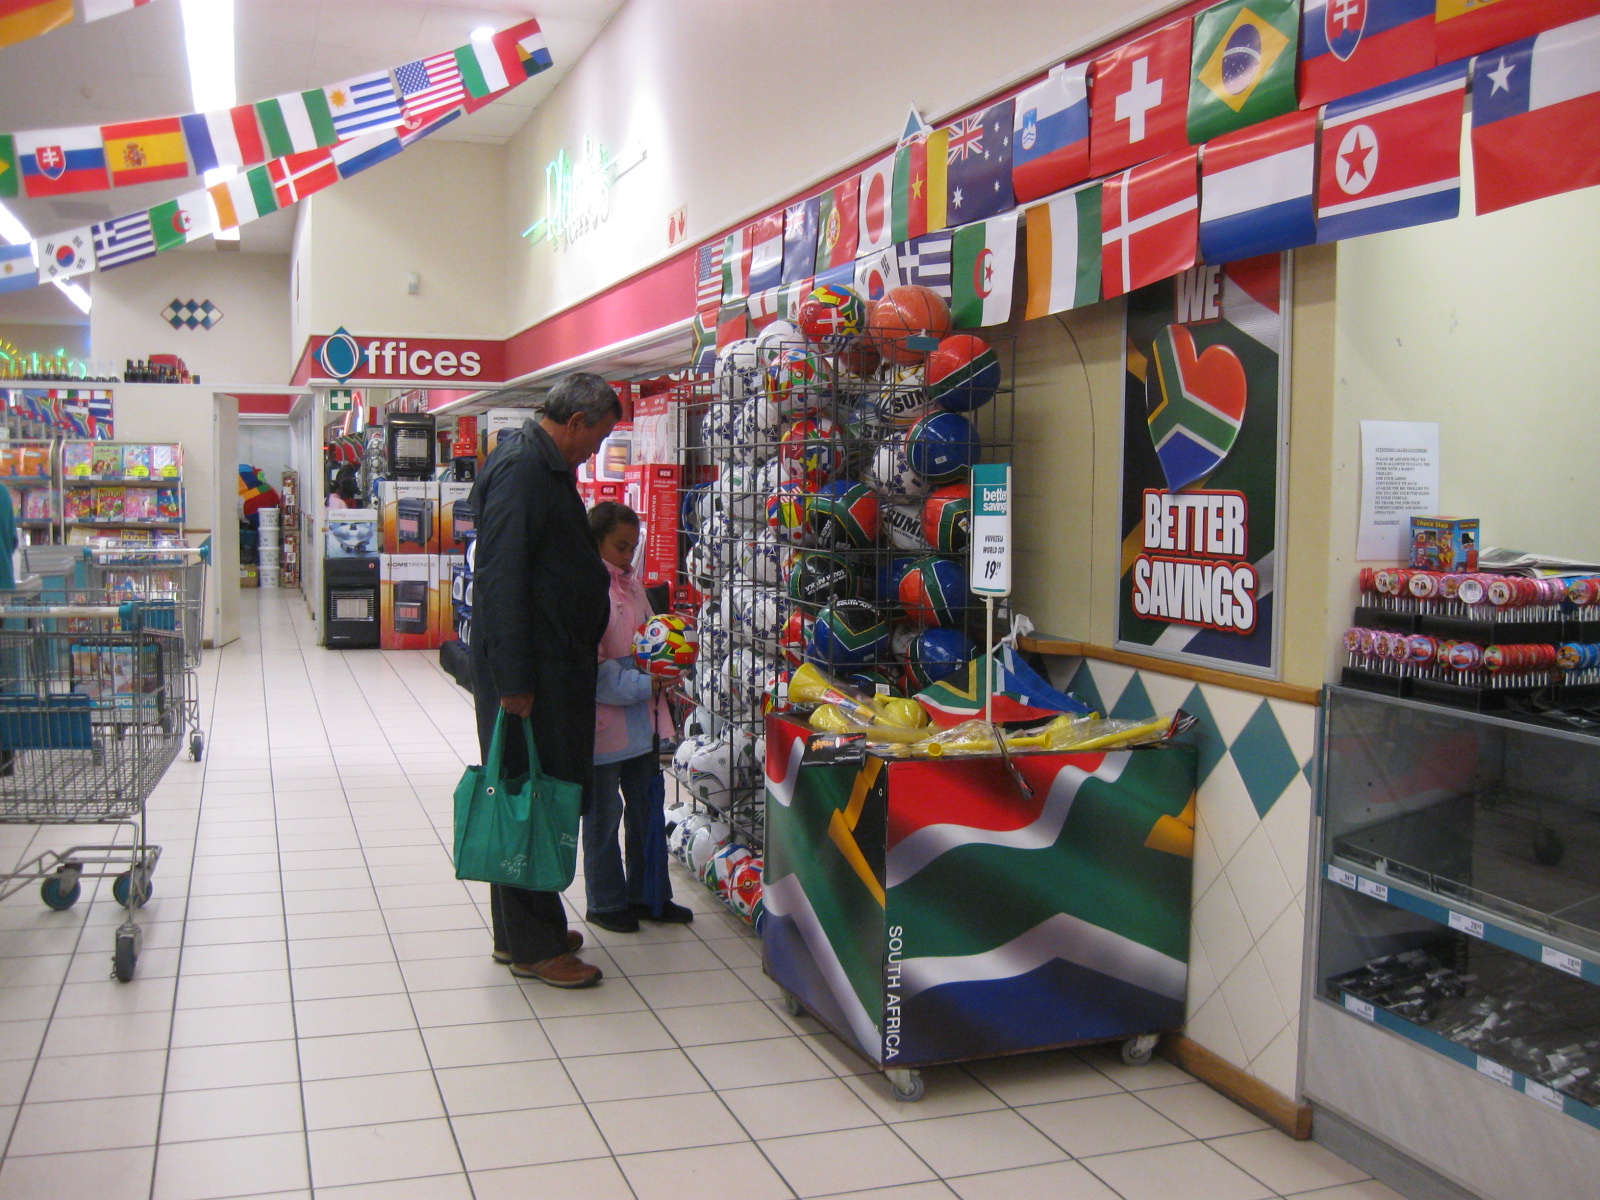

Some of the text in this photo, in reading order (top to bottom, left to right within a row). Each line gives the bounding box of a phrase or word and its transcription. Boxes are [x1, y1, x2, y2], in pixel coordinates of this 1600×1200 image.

[1176, 264, 1221, 324] WE
[320, 333, 482, 379] Offices
[1144, 493, 1245, 555] BETTER
[1134, 559, 1254, 630] SAVINGS
[885, 925, 903, 1061] SOUTH AFRICA
